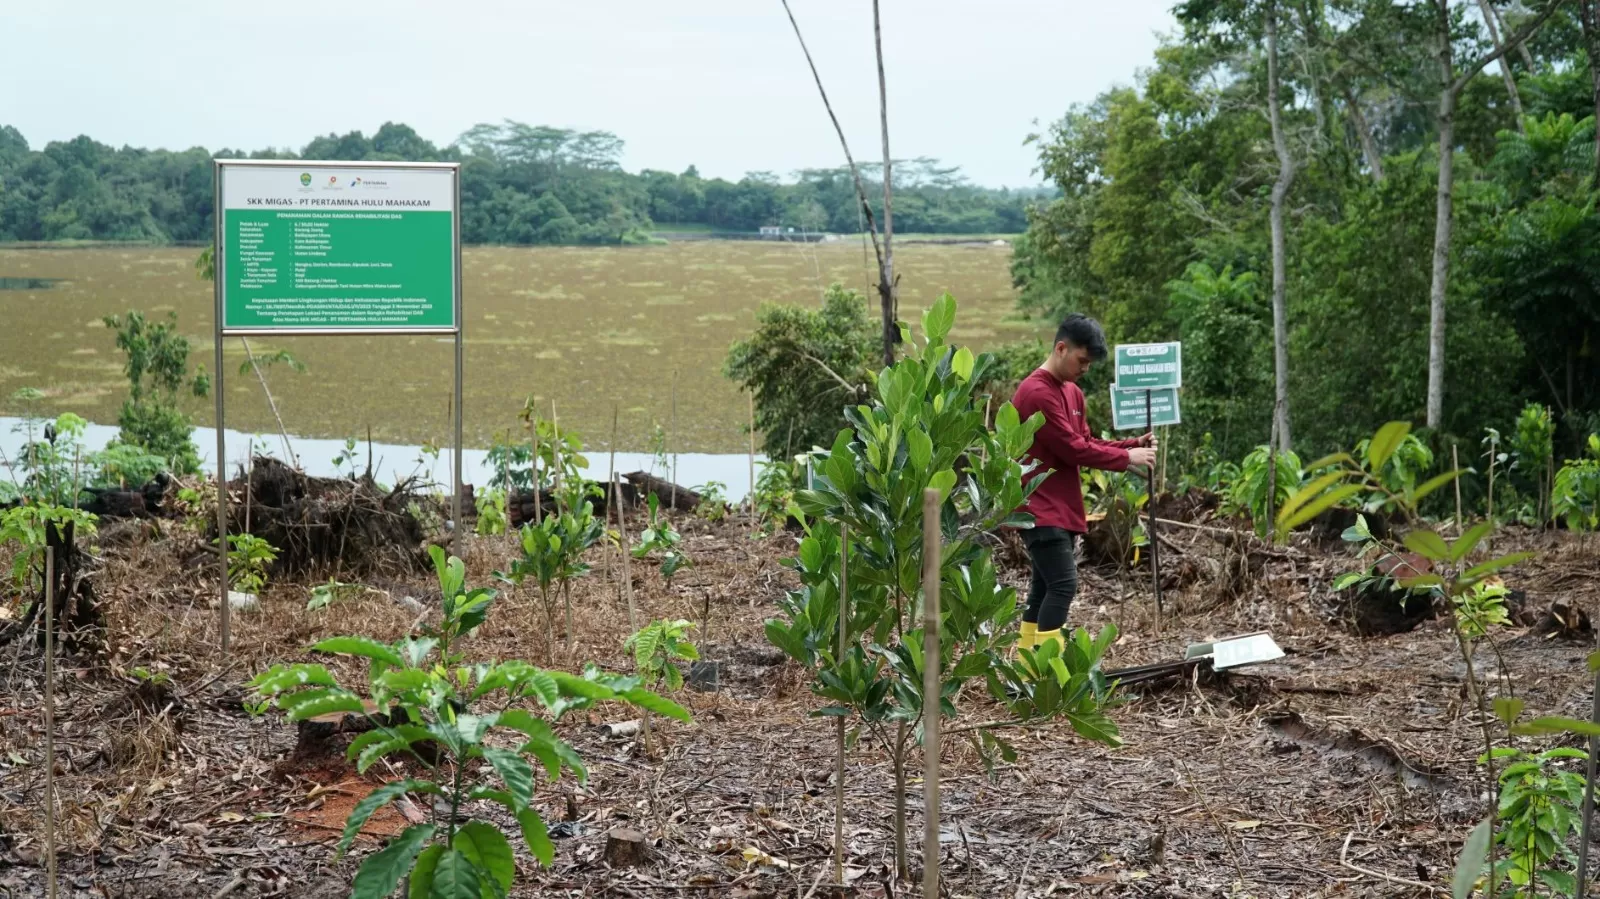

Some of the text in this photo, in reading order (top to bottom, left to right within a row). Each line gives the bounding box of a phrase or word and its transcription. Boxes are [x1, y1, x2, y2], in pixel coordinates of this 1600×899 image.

[300, 198, 309, 206] PT
[311, 198, 359, 206] PERTAMINA
[386, 199, 430, 207] MAHAKAM
